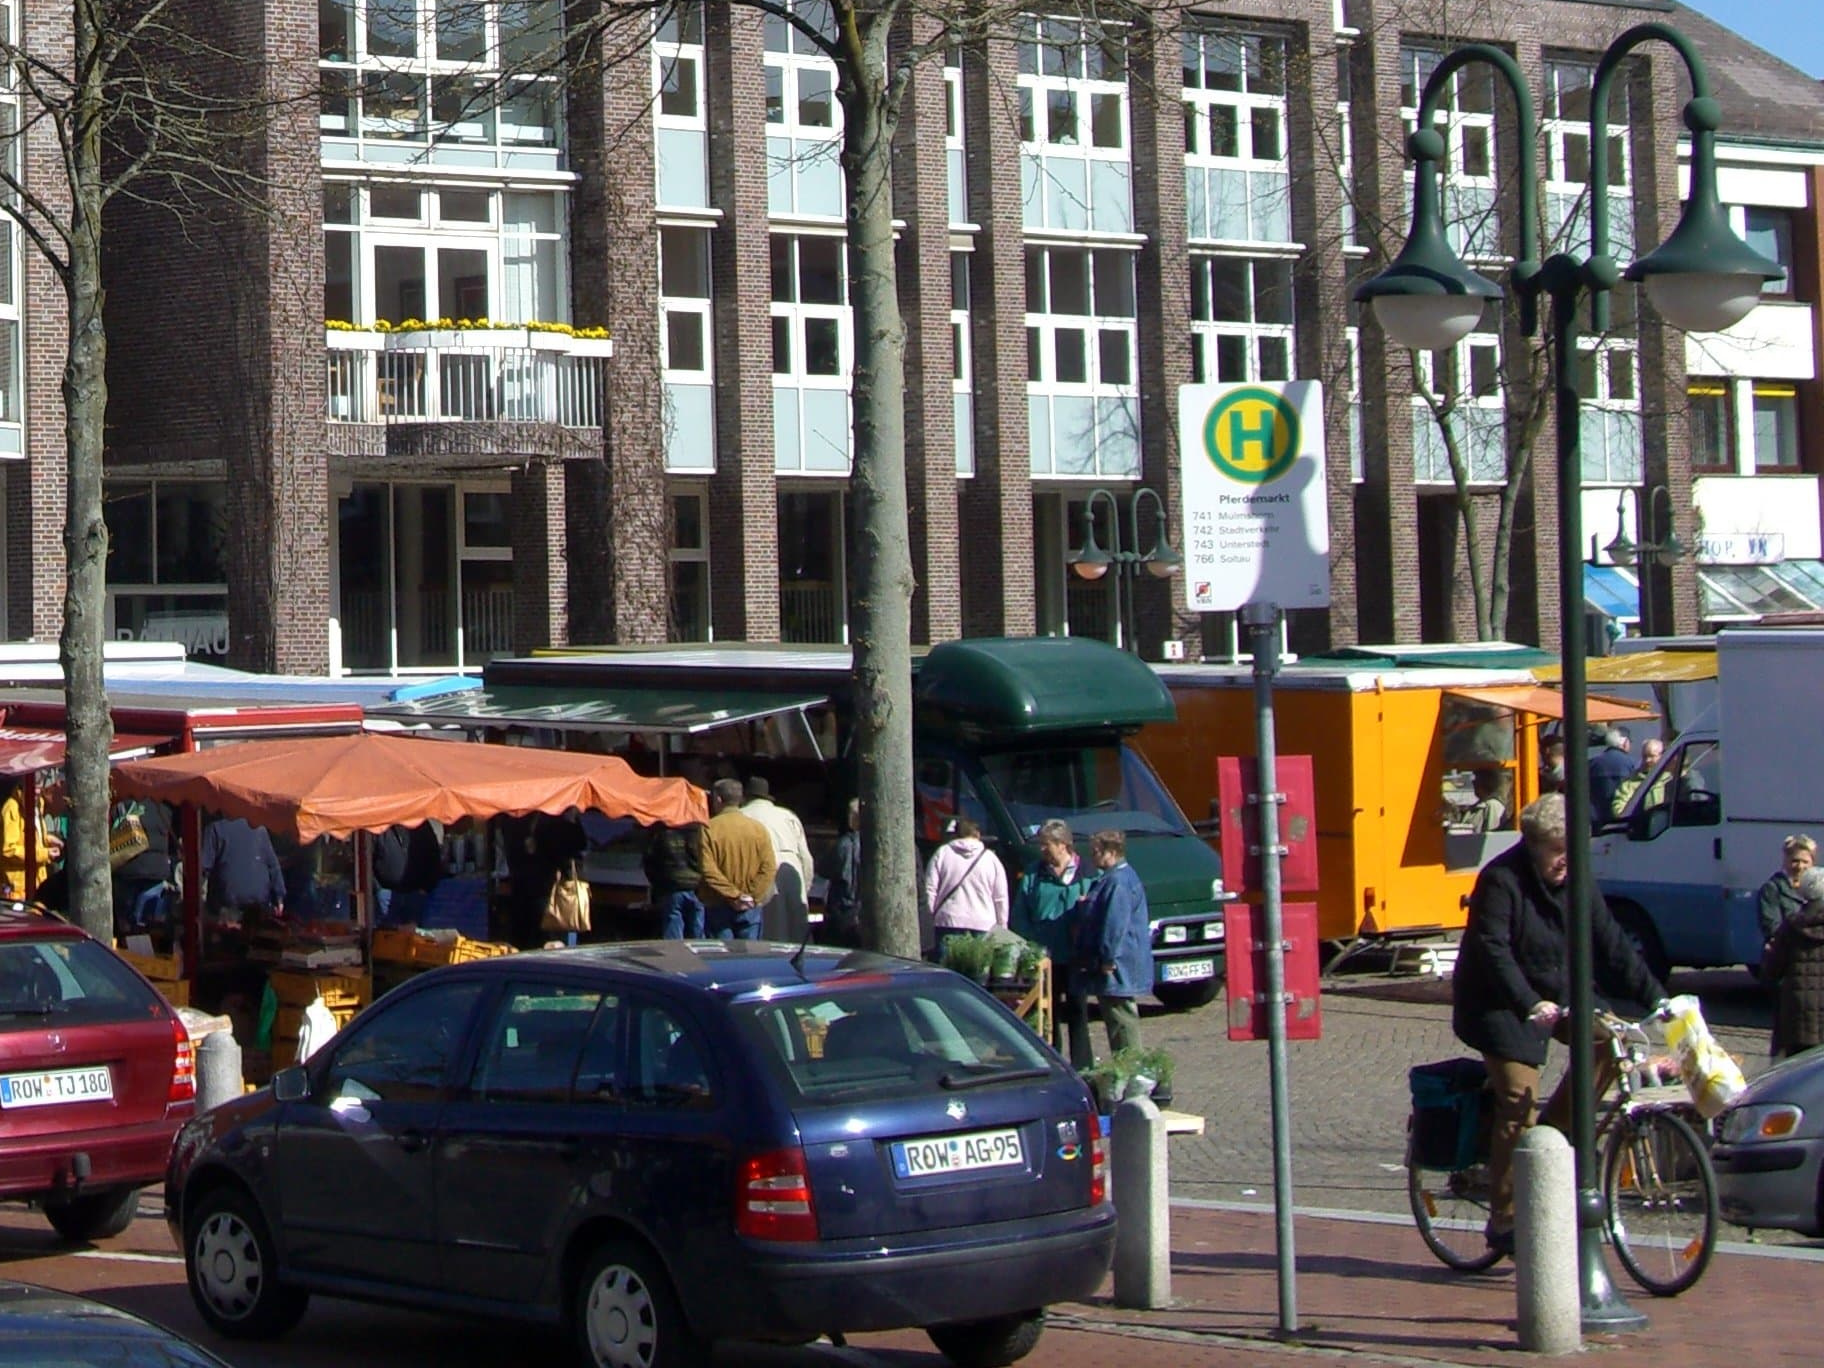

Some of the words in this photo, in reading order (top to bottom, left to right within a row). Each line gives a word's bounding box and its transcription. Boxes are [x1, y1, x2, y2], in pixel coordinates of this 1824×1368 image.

[1229, 410, 1274, 461] H
[1219, 494, 1290, 504] Pferdemarkt
[1192, 512, 1212, 521] 741
[1194, 526, 1213, 535] 742
[1194, 540, 1214, 549] 743
[1194, 554, 1215, 564] 766
[11, 1078, 42, 1099] ROW
[908, 1143, 949, 1172] ROW
